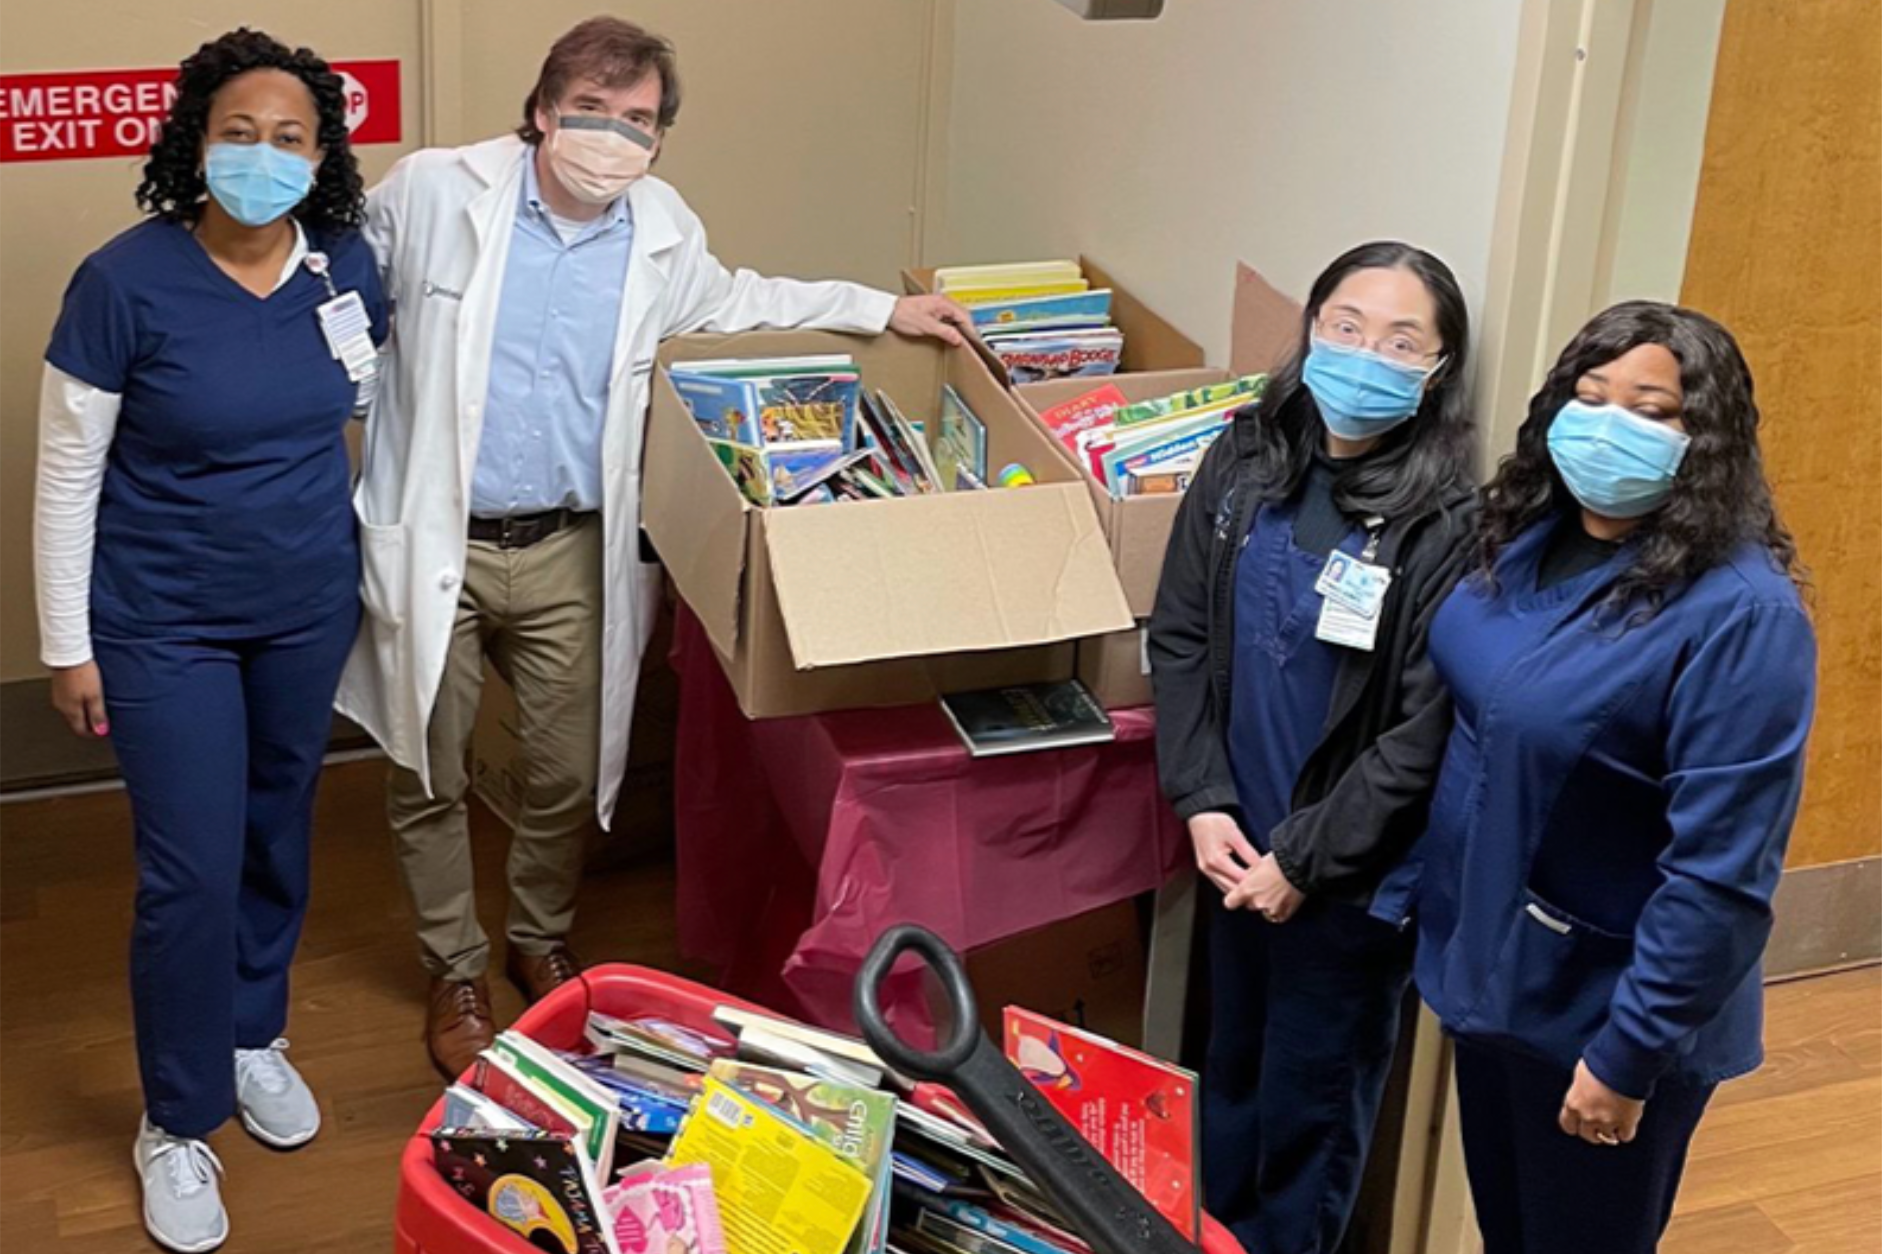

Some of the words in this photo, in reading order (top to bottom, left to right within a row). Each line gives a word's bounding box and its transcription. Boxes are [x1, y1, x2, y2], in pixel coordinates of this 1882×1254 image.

[0, 82, 179, 118] MERGEN
[12, 119, 103, 151] EXIT
[114, 116, 172, 147] ON
